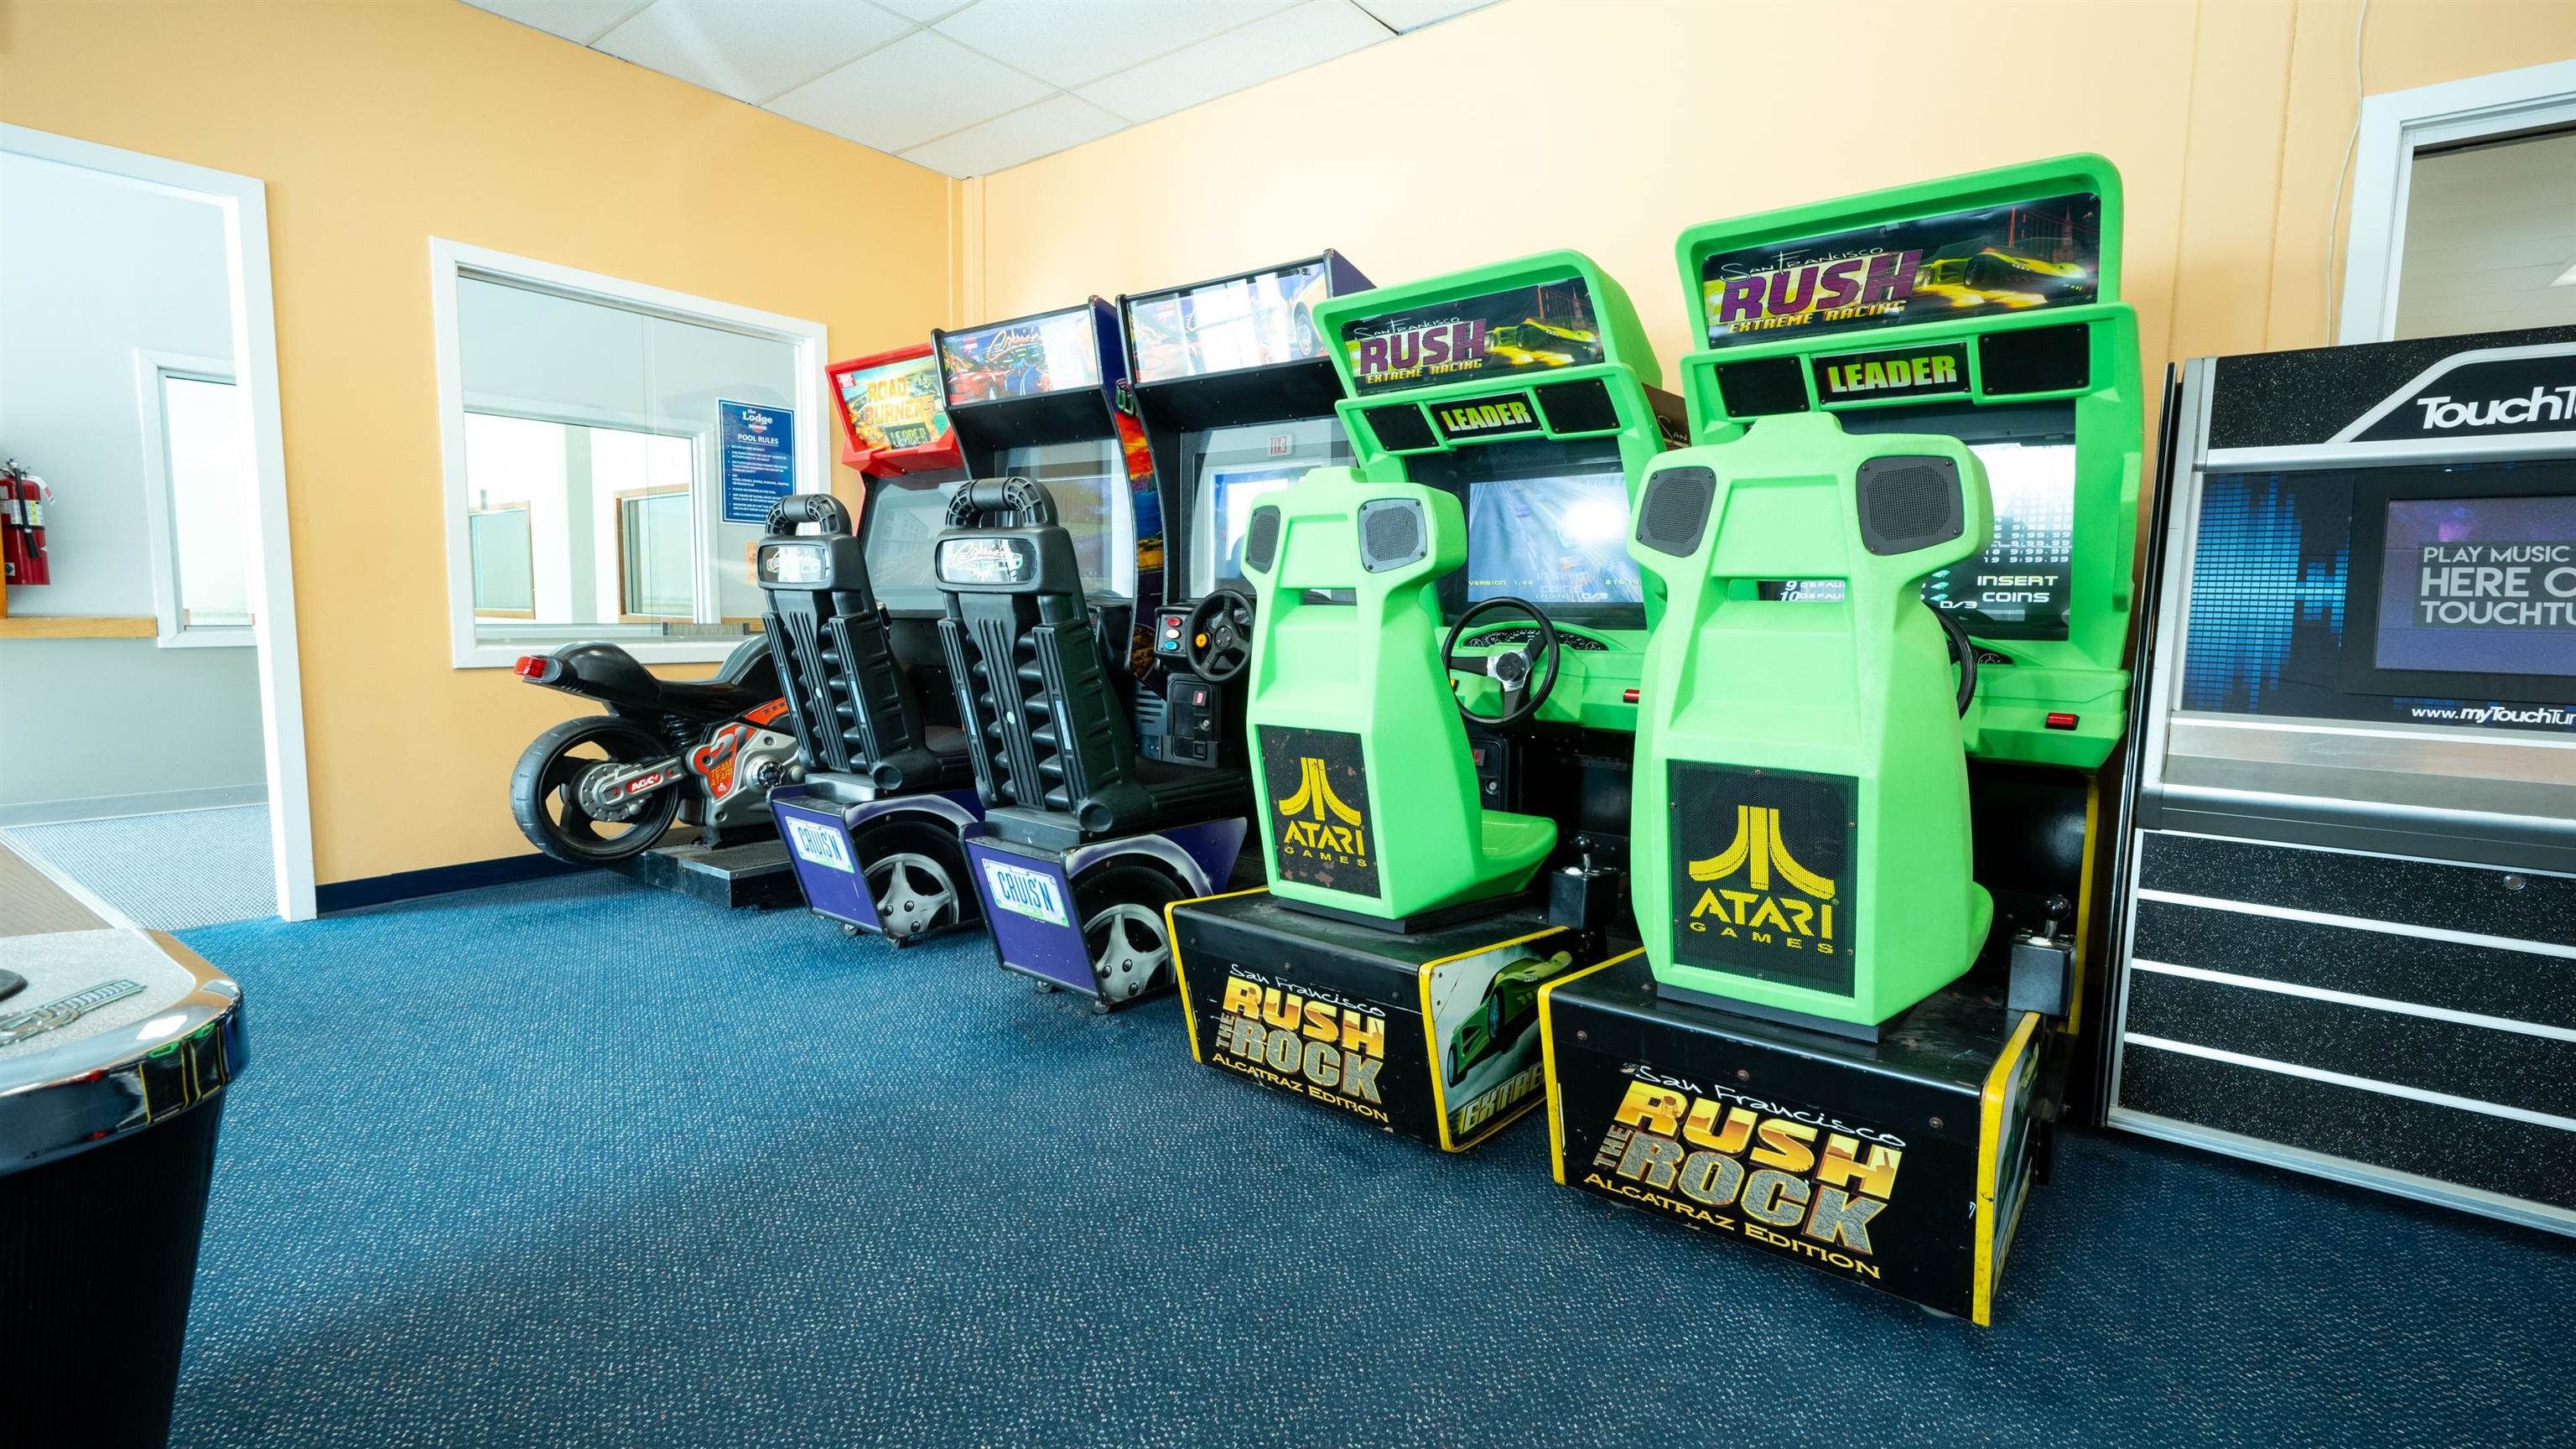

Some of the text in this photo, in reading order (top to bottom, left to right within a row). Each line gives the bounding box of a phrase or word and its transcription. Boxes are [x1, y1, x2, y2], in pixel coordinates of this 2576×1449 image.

[1719, 248, 1924, 323] RUSH
[1726, 299, 1908, 335] EXTREME RACING
[1360, 319, 1487, 375] RUSH
[1366, 358, 1483, 384] EXTREME RACING
[1826, 355, 1957, 393] LEADER
[867, 376, 907, 403] ROAD
[2417, 386, 2576, 429] TouchT
[742, 411, 773, 425] Lodge
[1441, 401, 1532, 432] LEADER
[738, 434, 779, 444] POOL RULES
[891, 428, 927, 448] LEADER
[2423, 546, 2571, 563] PLAY MUSIC
[1780, 590, 1800, 602] 10
[1784, 580, 1798, 591] 9
[1977, 575, 2059, 586] INSERT
[1982, 591, 2050, 603] COINS
[2421, 567, 2576, 598] HERE O
[1940, 600, 1978, 609] 0/3
[2412, 706, 2576, 725] www.myTouchTun
[710, 725, 747, 767] 21
[711, 759, 732, 776] TEAM
[798, 827, 843, 861] CRUIS'N
[1284, 819, 1365, 856] ATARI
[1284, 846, 1368, 867] GAMES
[997, 870, 1054, 912] CRUIS'N
[1690, 887, 1833, 939] ATARI
[1690, 922, 1834, 954] GAMES
[1230, 963, 1386, 1018] San Francisco
[1215, 1011, 1237, 1047] THE
[1222, 975, 1385, 1060] RUSH
[1229, 1015, 1384, 1105] ROCK
[1212, 1052, 1389, 1124] ALCATRAZ EDITION
[1459, 1061, 1545, 1135] EXTRE
[1635, 1065, 1906, 1148] San Francisco
[1593, 1124, 1633, 1171] THE
[1613, 1079, 1903, 1200] RUSH
[1615, 1130, 1888, 1256] ROCK
[1582, 1173, 1881, 1280] ALCATRAZ EDITION
